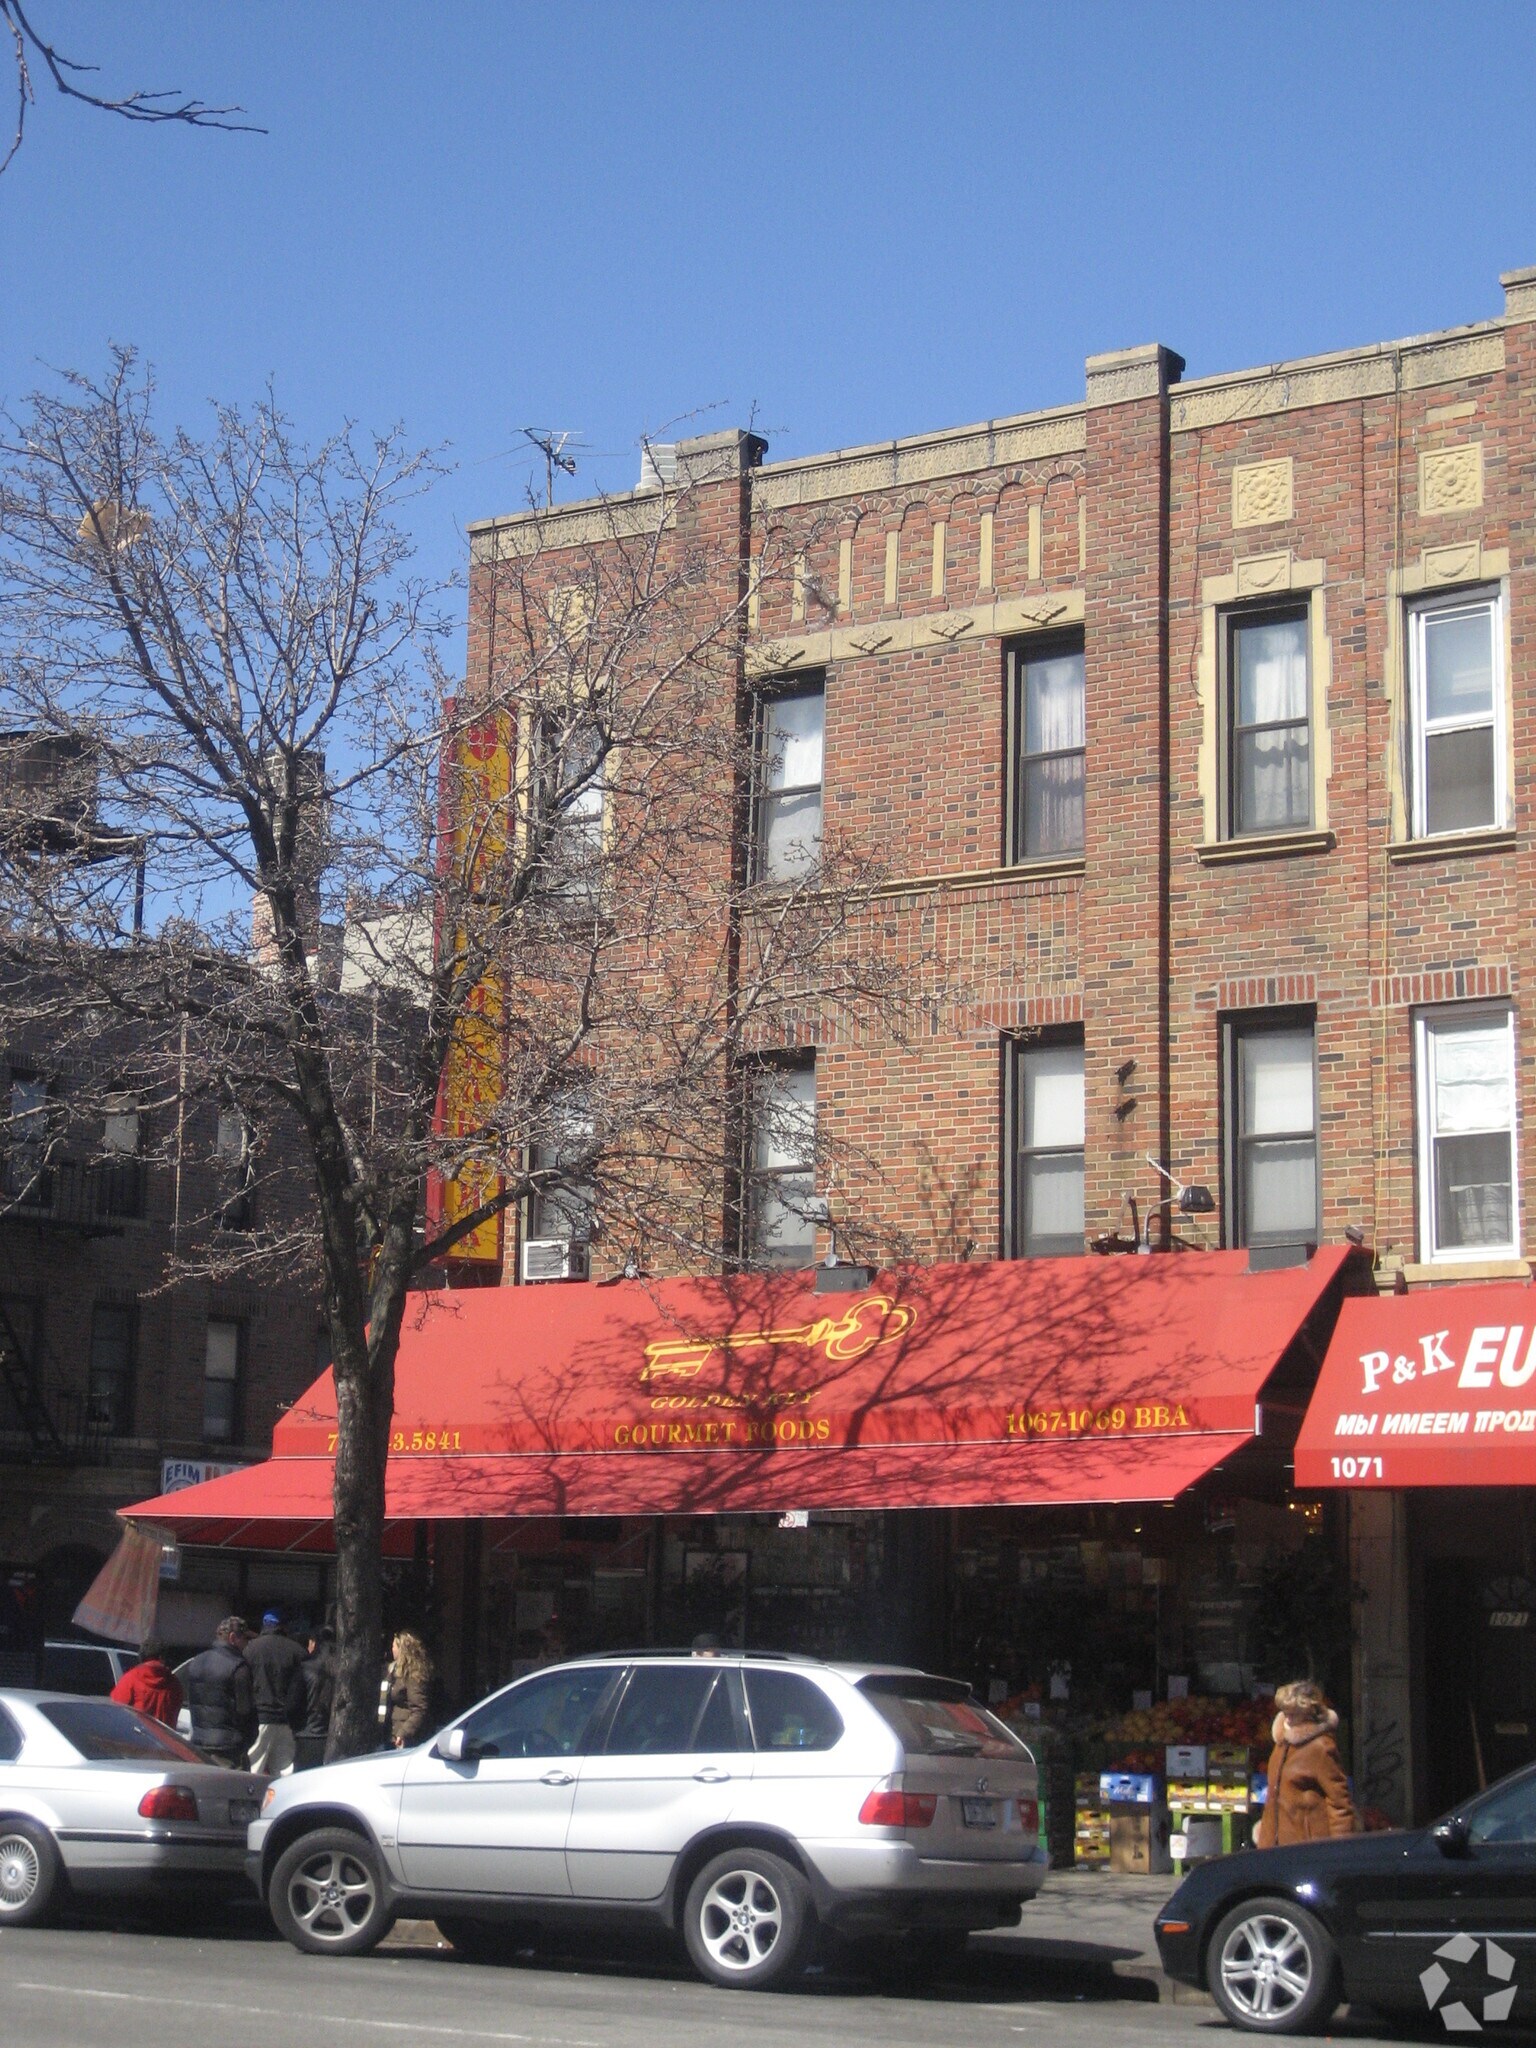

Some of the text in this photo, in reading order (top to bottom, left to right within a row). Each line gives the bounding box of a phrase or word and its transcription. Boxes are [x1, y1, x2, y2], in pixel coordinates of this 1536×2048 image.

[1359, 1325, 1536, 1394] P&K EU
[614, 1418, 831, 1445] GOURMET FOODS
[1006, 1404, 1189, 1434] 1067-1069 BBA
[1381, 1412, 1469, 1435] ИМЕЕМ
[165, 1463, 200, 1485] EFIM
[1331, 1457, 1383, 1479] 1071
